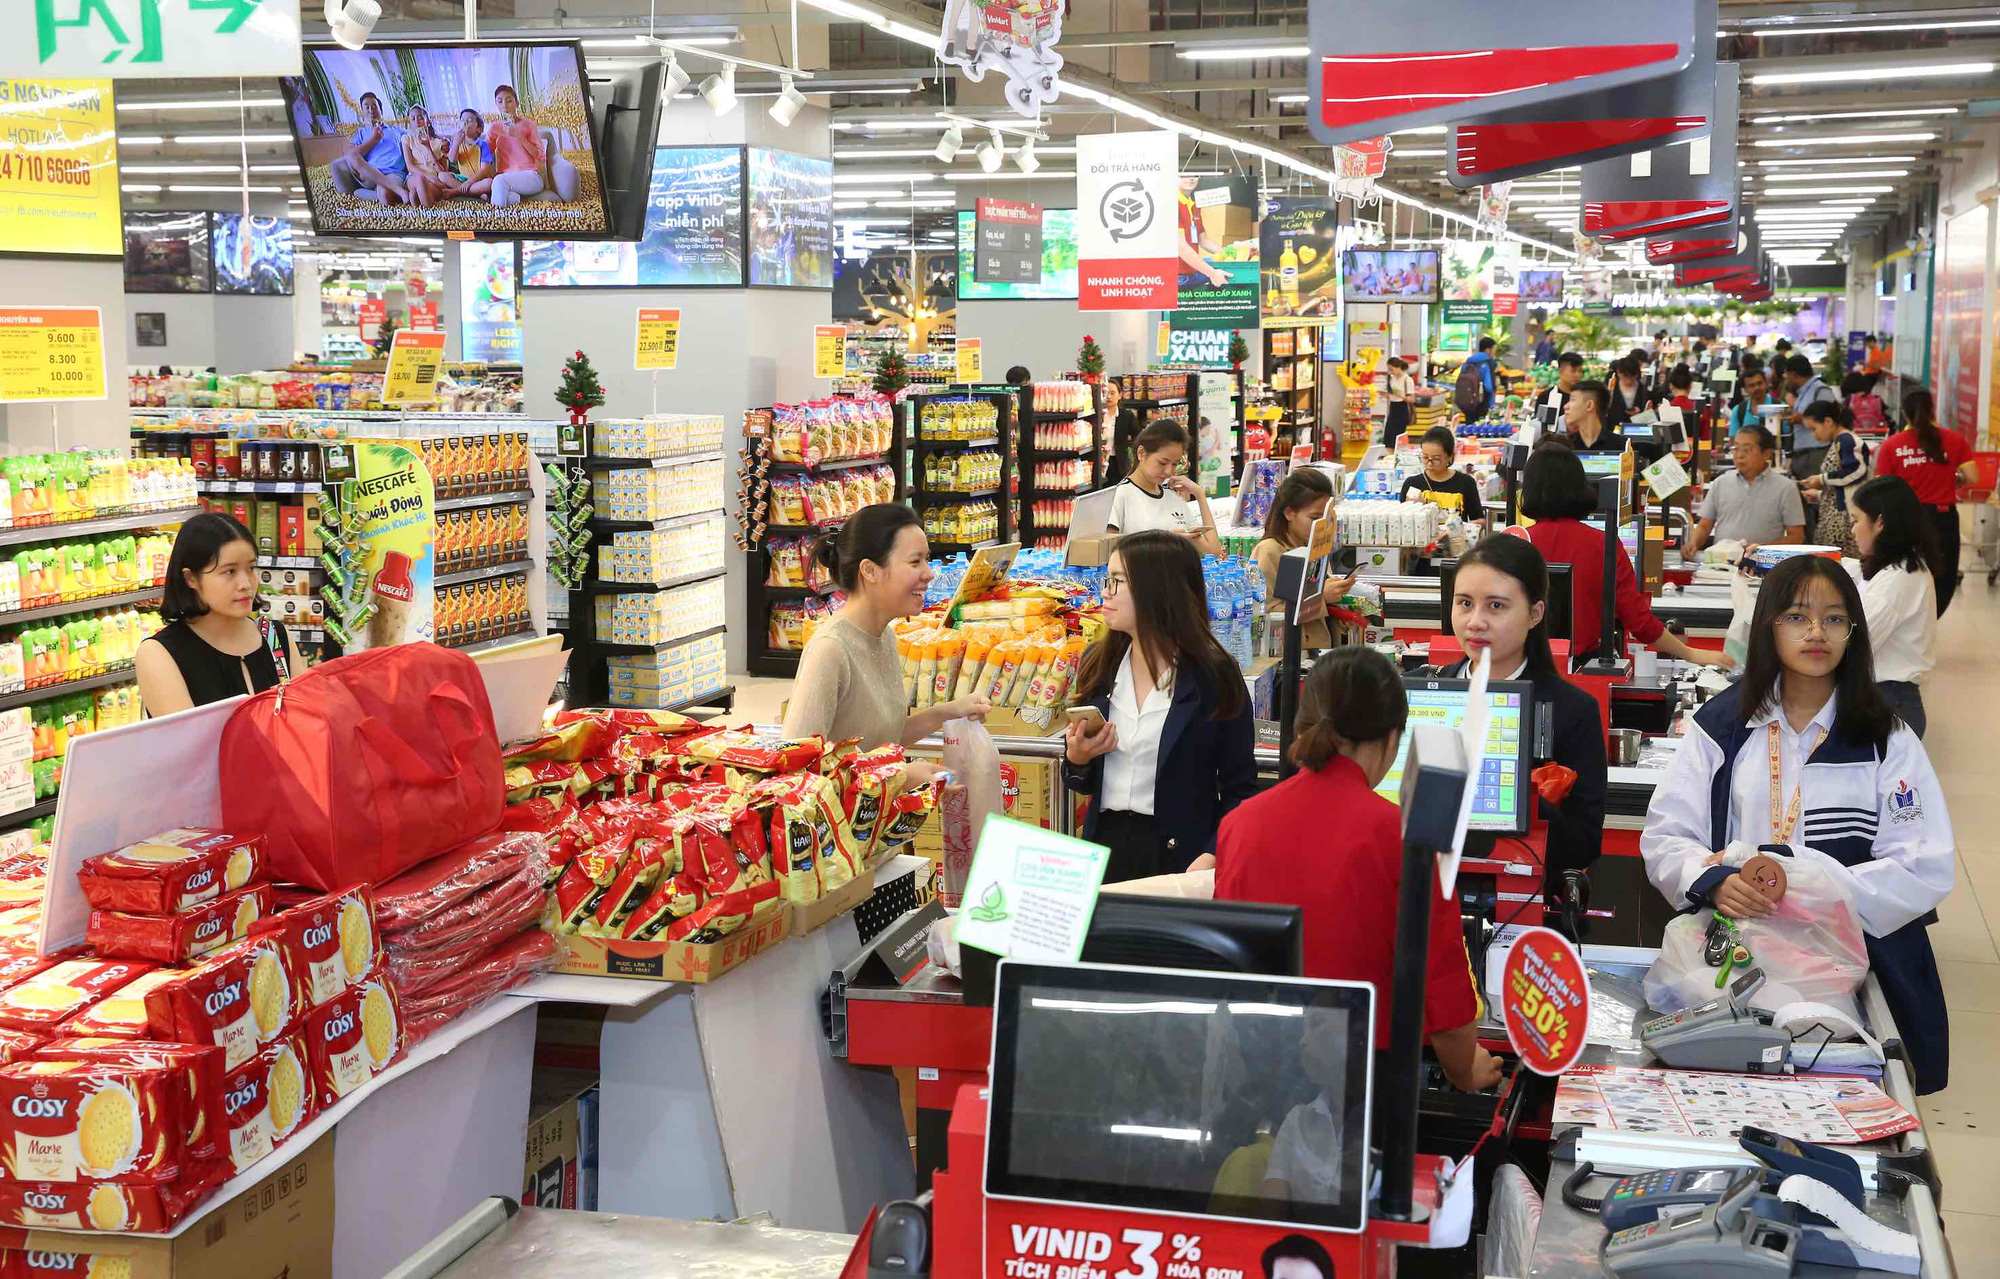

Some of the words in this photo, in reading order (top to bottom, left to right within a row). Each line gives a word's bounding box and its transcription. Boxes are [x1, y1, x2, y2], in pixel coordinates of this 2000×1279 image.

[987, 14, 1009, 26] VinMart
[15, 153, 44, 182] 710
[656, 197, 683, 210] app
[687, 193, 724, 207] VinID
[665, 212, 698, 228] miễn
[1088, 277, 1123, 287] NHANH
[1125, 275, 1165, 287] CHÓNG,
[1101, 288, 1123, 297] LINH
[1194, 290, 1215, 298] CUNG
[1231, 289, 1252, 298] XANH
[47, 333, 75, 343] 9.600
[494, 328, 517, 337] LESS
[490, 338, 521, 348] RIGHT
[49, 354, 76, 364] 8.300
[1171, 344, 1229, 362] XANH
[51, 371, 83, 381] 10.000
[357, 463, 417, 499] NESCAFÉ
[377, 582, 410, 599] NESCAFÉ
[1490, 761, 1496, 770] 9
[185, 868, 215, 891] COSY
[195, 917, 223, 939] COSY
[303, 922, 332, 949] COSY
[86, 965, 130, 986] COSY
[317, 964, 335, 979] Marie
[205, 979, 243, 1017] COSY
[1522, 983, 1570, 1041] 50%
[222, 1025, 244, 1046] Marie
[324, 1011, 354, 1042] COSY
[340, 1052, 360, 1071] Marie
[12, 1095, 68, 1118] COSY
[225, 1079, 260, 1115] COSY
[239, 1123, 259, 1146] Marie
[27, 1140, 62, 1155] Marie
[23, 1191, 67, 1210] COSY
[27, 1249, 79, 1270] COSY
[1010, 1224, 1112, 1262] VINID
[1115, 1228, 1164, 1279] 3
[1172, 1234, 1202, 1262] %
[1005, 1257, 1051, 1279] TÍCH
[1166, 1261, 1202, 1279] HÓA
